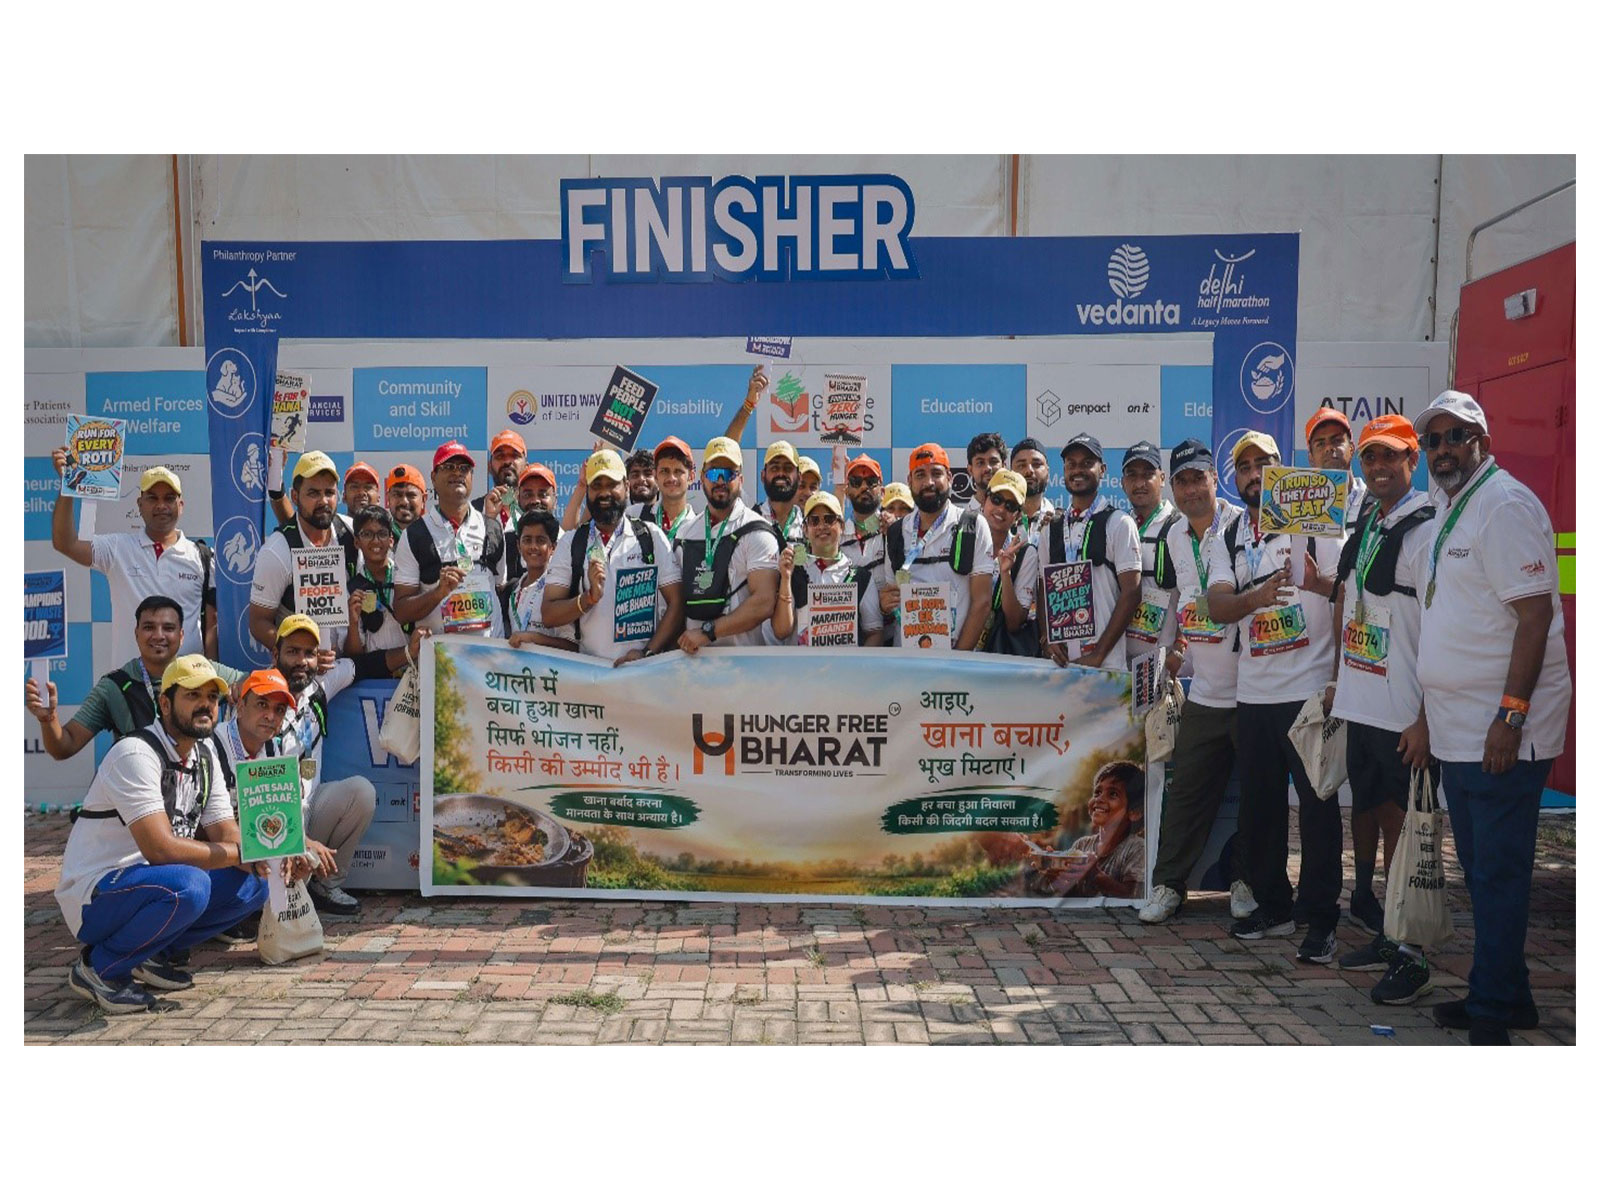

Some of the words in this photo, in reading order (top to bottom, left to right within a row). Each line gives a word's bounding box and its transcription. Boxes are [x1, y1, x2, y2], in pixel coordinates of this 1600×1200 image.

[567, 184, 909, 273] FINISHER
[213, 250, 265, 262] Philanthropy
[267, 251, 296, 261] Partner
[1200, 263, 1245, 297] delhi
[1198, 295, 1219, 309] half
[1223, 295, 1269, 308] marathon
[1076, 299, 1180, 325] vedanta
[1198, 317, 1220, 327] Legacy
[379, 379, 462, 398] Community
[620, 376, 645, 398] FEED
[33, 399, 71, 411] Patients
[103, 397, 150, 413] Armed
[155, 396, 203, 412] Forces
[541, 394, 577, 407] UNITED
[579, 393, 602, 407] WAY
[921, 398, 994, 414] Education
[310, 409, 341, 417] RVICES
[390, 402, 416, 417] and
[420, 401, 451, 417] Skill
[610, 399, 636, 419] NOT
[656, 399, 723, 417] Disability
[1067, 401, 1110, 415] genpact
[1128, 405, 1140, 414] on
[1141, 403, 1149, 414] it
[1184, 402, 1213, 417] Elde
[542, 411, 552, 421] of
[555, 411, 580, 421] Delhi
[77, 428, 97, 439] RUN
[99, 428, 116, 438] FOR
[373, 424, 469, 442] Development
[78, 439, 115, 451] EVERY
[82, 451, 113, 464] ROTI
[24, 479, 60, 490] neurs
[1286, 476, 1309, 490] RUN
[1311, 475, 1327, 487] SO
[1282, 490, 1305, 502] THEY
[1308, 486, 1330, 499] CAN
[1291, 499, 1325, 517] EAT
[308, 559, 340, 567] BHARAT
[300, 573, 339, 587] FUEL
[620, 573, 635, 587] ONE
[1050, 567, 1073, 583] STEP
[1074, 563, 1086, 574] BY
[299, 586, 342, 597] PEOPLE,
[617, 586, 633, 601] ONE
[823, 595, 852, 603] BHARAT
[1048, 587, 1077, 606] PLATE
[1079, 584, 1091, 595] BY
[24, 592, 63, 608] AMPIONS
[307, 596, 335, 608] NOT
[449, 598, 485, 612] 72068
[905, 599, 920, 613] EK
[616, 600, 629, 617] ONE
[1134, 608, 1157, 623] 043
[811, 611, 856, 626] MARATHON
[918, 611, 934, 622] EK
[627, 625, 653, 635] BHARAT
[815, 623, 851, 635] AGAINST
[1255, 615, 1293, 634] 72016
[812, 633, 856, 647] HUNGER.
[1064, 629, 1093, 638] BHARAT
[1347, 627, 1378, 649] 72074
[486, 666, 535, 694] थाली
[541, 668, 558, 695] में
[486, 697, 520, 715] बचा
[524, 699, 559, 723] हुआ
[563, 702, 605, 719] खाना
[920, 690, 974, 716] आइए,
[741, 714, 829, 733] HUNGER
[837, 714, 888, 733] FREE
[486, 721, 526, 748] सिर्फ
[531, 723, 582, 750] भोजन
[586, 727, 624, 755] नहीं,
[920, 722, 986, 749] खाना
[990, 714, 1069, 756] बचाएं,
[24, 738, 45, 753] LL
[741, 737, 888, 767] BHARAT
[486, 749, 535, 775] किसी
[540, 752, 564, 776] की
[570, 754, 622, 781] उम्मीद
[627, 756, 651, 780] भी
[918, 758, 956, 783] भूख
[775, 769, 831, 778] TRANSFORMING
[833, 770, 853, 778] LIVES
[243, 783, 270, 797] PLATE
[248, 795, 264, 808] DIL
[583, 796, 607, 806] खाना
[609, 796, 634, 808] बर्बाद
[635, 799, 662, 809] करना
[921, 799, 934, 811] हर
[936, 799, 956, 811] बचा
[958, 799, 978, 812] हुआ
[981, 798, 1016, 810] निवाला
[566, 808, 601, 819] मानवता
[603, 808, 613, 820] के
[615, 810, 635, 821] साथ
[637, 812, 668, 823] अन्याय
[898, 813, 924, 826] किसी
[925, 813, 939, 826] की
[942, 813, 973, 828] जिंदगी
[975, 816, 999, 827] बदल
[1000, 816, 1029, 827] सकता
